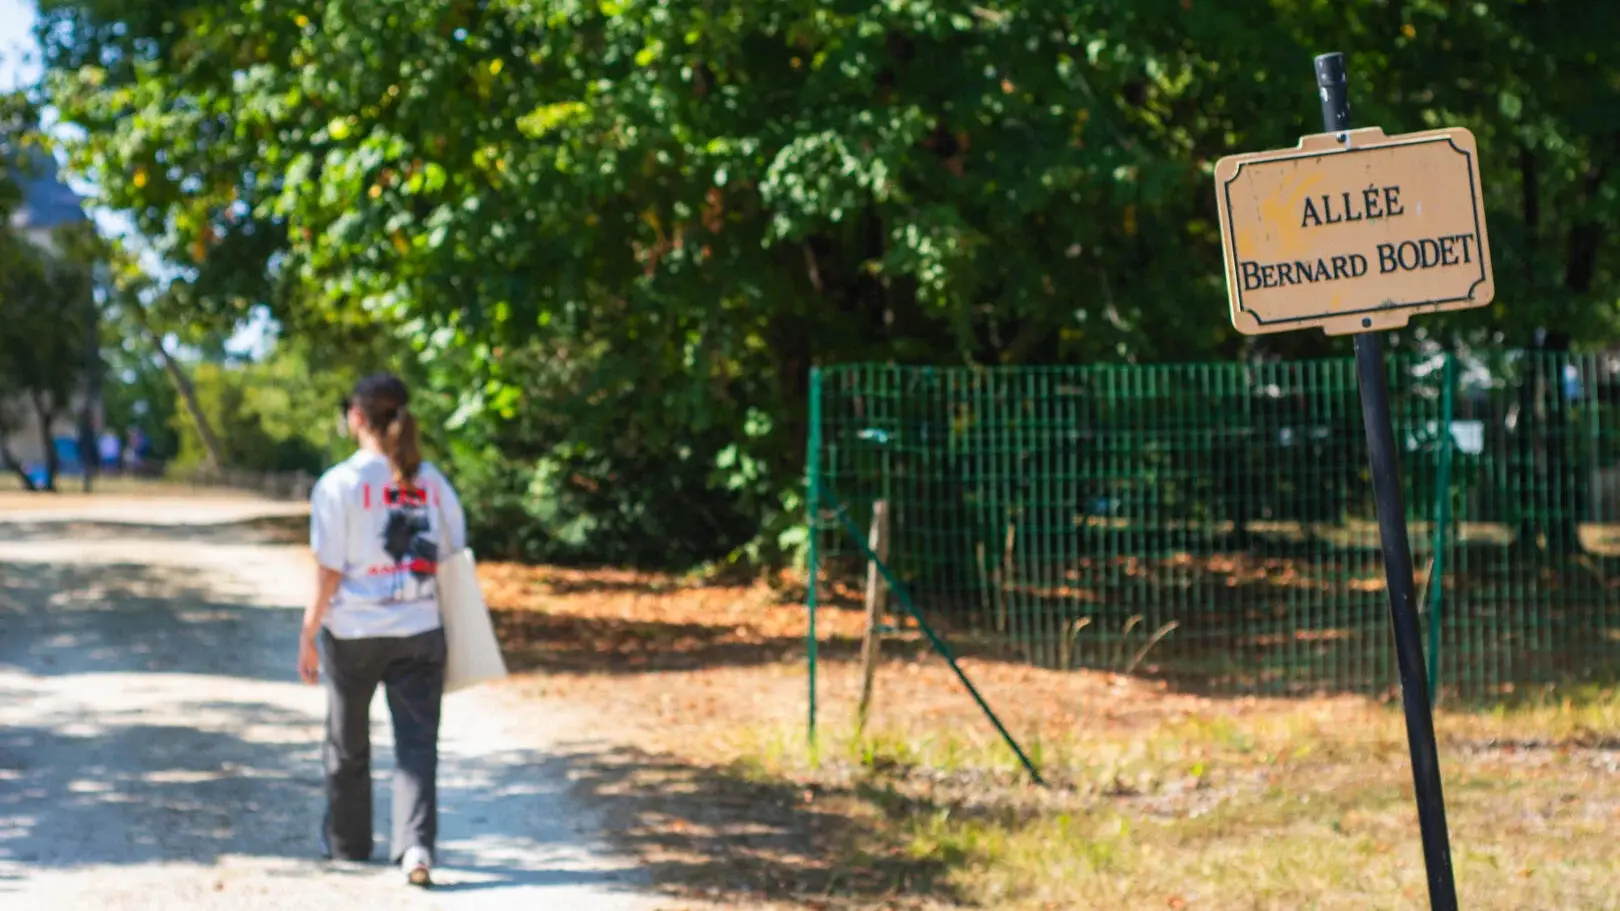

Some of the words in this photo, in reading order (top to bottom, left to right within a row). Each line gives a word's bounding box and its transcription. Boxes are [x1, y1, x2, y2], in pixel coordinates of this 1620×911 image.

[1301, 184, 1404, 228] ALLÉE
[1240, 254, 1368, 291] BERNARD
[1377, 233, 1474, 275] BODET
